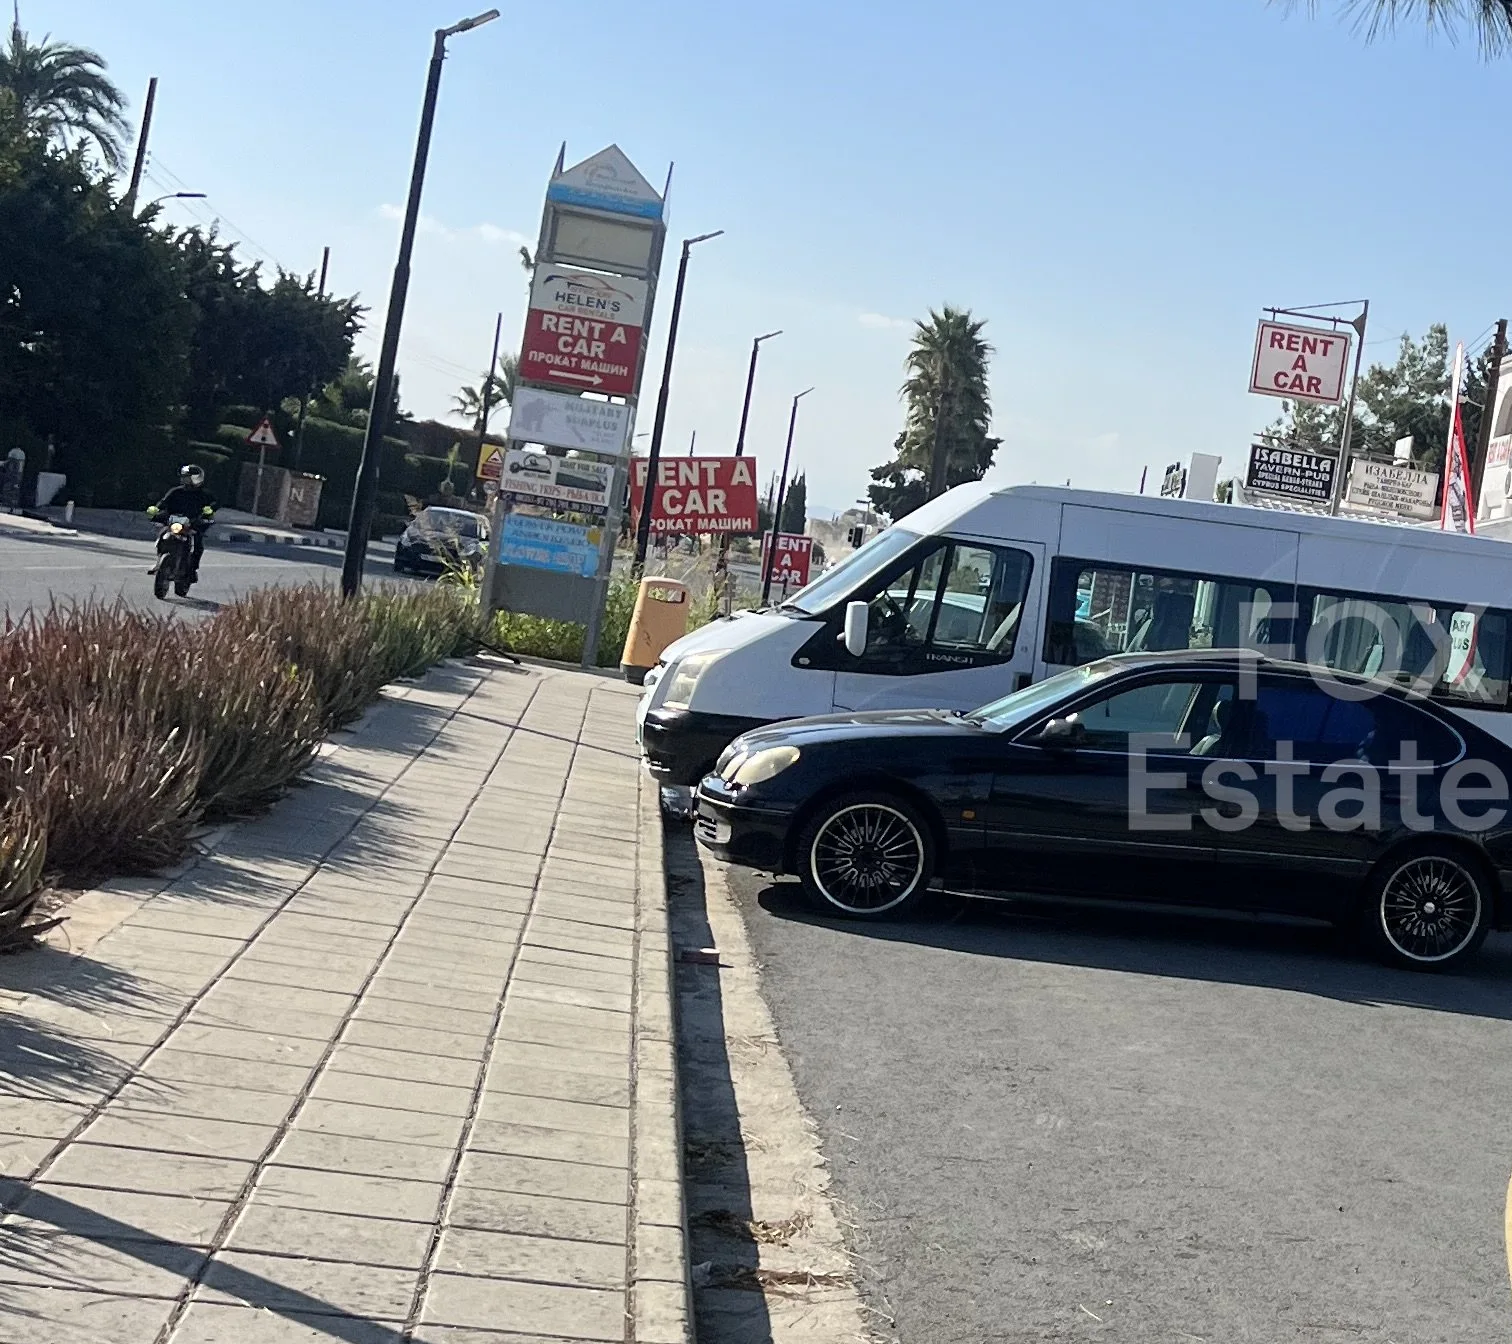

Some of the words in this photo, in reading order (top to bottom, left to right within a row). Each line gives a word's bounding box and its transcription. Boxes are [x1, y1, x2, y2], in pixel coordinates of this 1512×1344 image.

[555, 291, 620, 312] HELEN'S
[541, 313, 605, 339] RENT
[610, 326, 627, 344] A
[558, 336, 606, 358] CAR
[1269, 331, 1334, 356] RENT
[528, 350, 578, 368] ПРОКАТ
[580, 359, 628, 376] МАШИН
[1291, 354, 1308, 372] A
[1273, 371, 1322, 394] CAR
[1255, 448, 1332, 472] ISABELLA
[730, 460, 753, 487] A
[1365, 465, 1428, 485] ИЗАБЕЛЛА
[662, 489, 728, 515] CAR
[697, 518, 752, 531] МАШИН
[780, 553, 792, 567] A
[771, 568, 801, 584] CAR
[926, 653, 975, 665] TRANSIT
